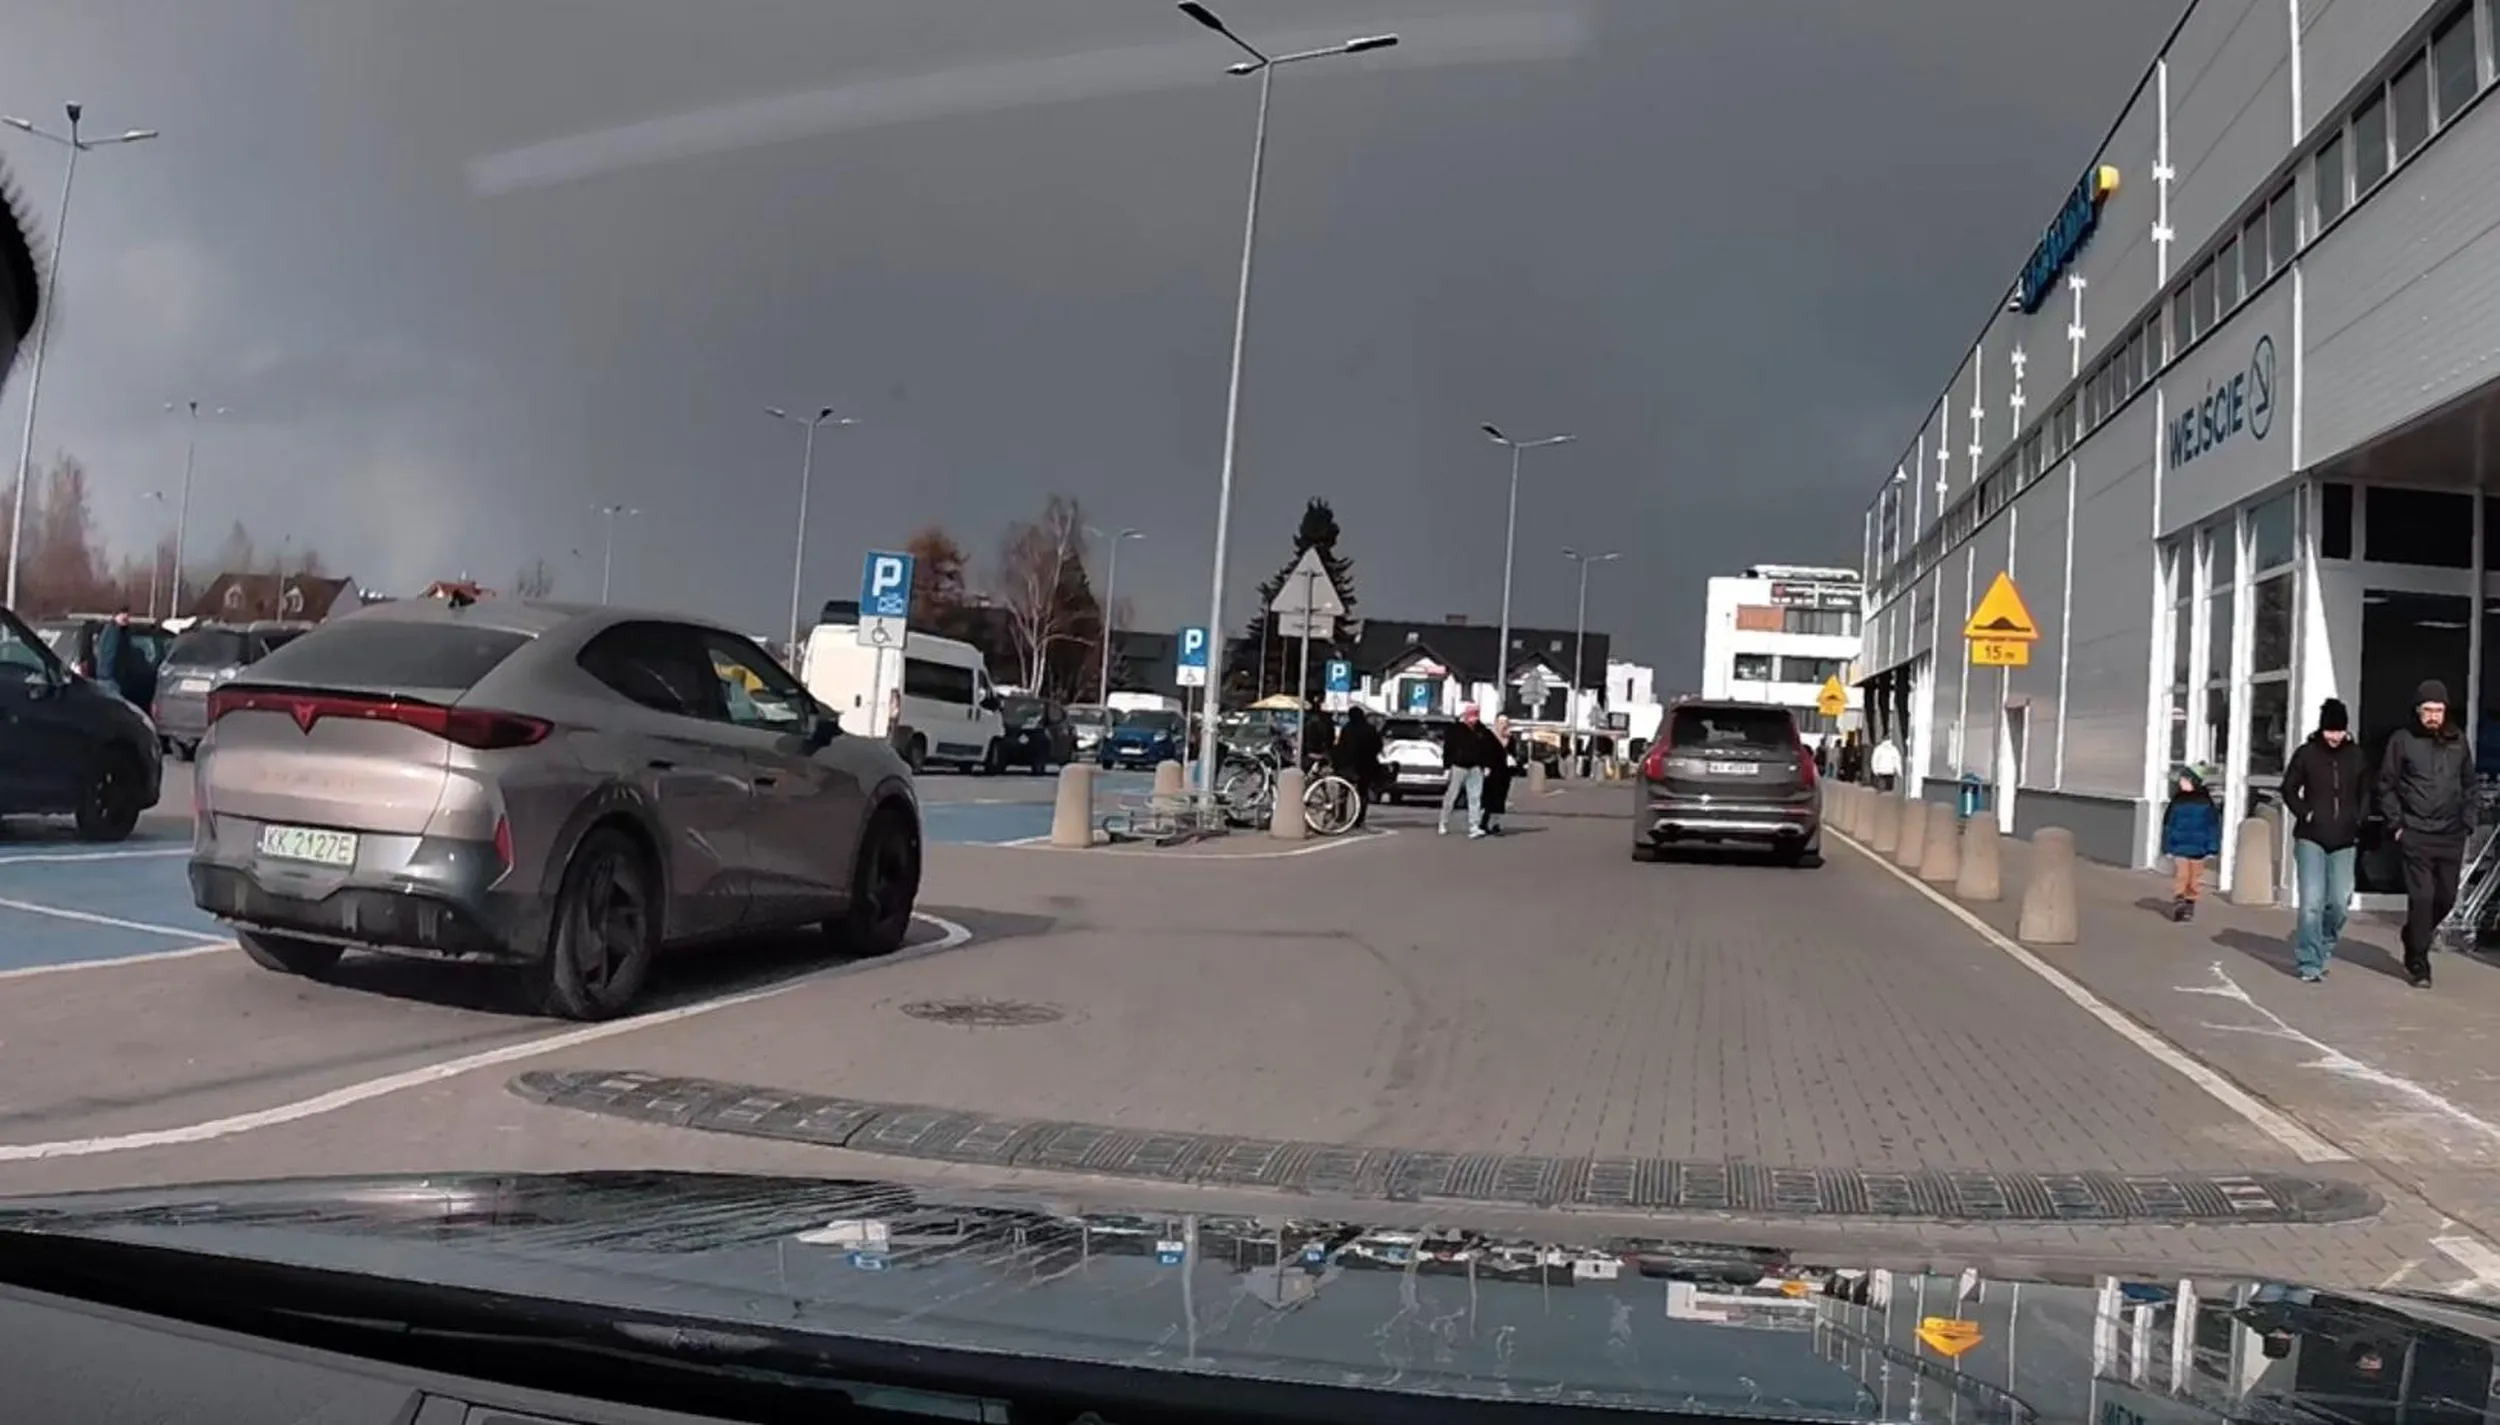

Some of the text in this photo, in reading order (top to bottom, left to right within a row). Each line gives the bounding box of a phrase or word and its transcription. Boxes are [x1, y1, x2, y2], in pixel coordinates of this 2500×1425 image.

[2169, 372, 2244, 470] WEJŚCIE
[872, 557, 902, 597] P
[1185, 629, 1203, 655] P
[1985, 645, 2002, 660] 15
[1332, 663, 1346, 682] P
